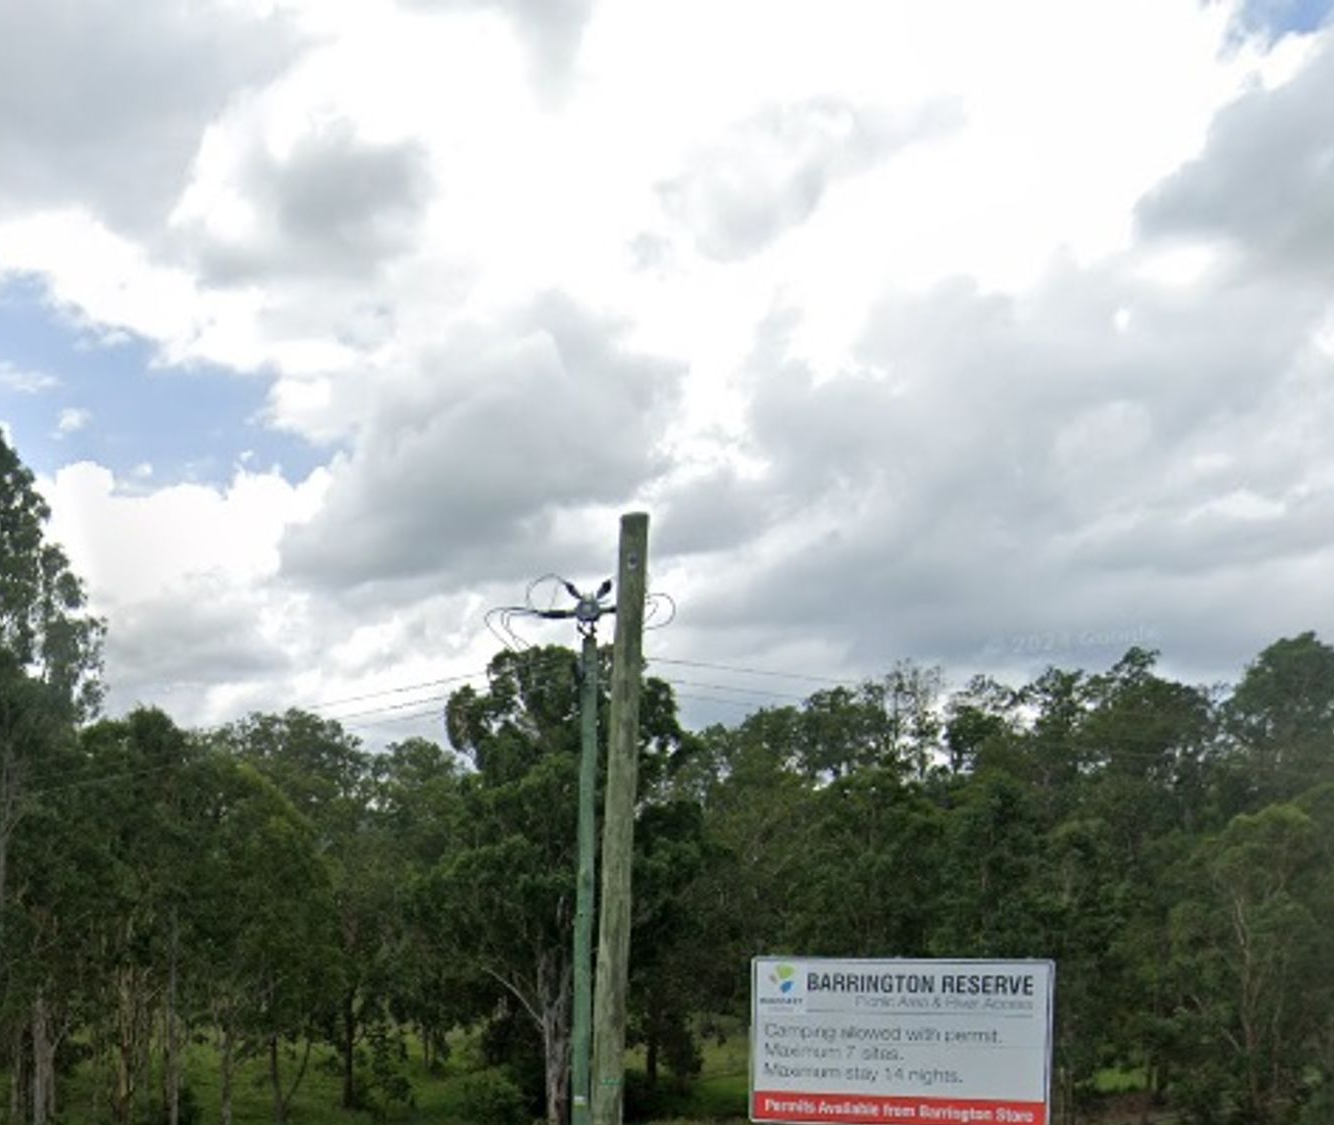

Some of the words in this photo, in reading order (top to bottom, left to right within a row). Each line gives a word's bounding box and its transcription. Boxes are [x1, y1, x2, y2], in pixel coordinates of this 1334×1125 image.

[806, 972, 935, 994] BARRINGTON
[941, 974, 1033, 996] RESERVE
[983, 998, 1034, 1011] Access
[764, 1023, 837, 1043] Camping
[840, 1026, 901, 1041] allowed
[905, 1026, 941, 1041] with
[764, 1042, 842, 1059] Maximum
[764, 1062, 841, 1079] Maximum
[845, 1066, 879, 1083] stay
[884, 1067, 904, 1081] 14
[908, 1068, 964, 1086] nights.
[764, 1098, 817, 1114] Permits
[818, 1101, 879, 1117] Available
[883, 1103, 916, 1117] from
[918, 1104, 993, 1122] Barrington
[995, 1107, 1034, 1123] Store
